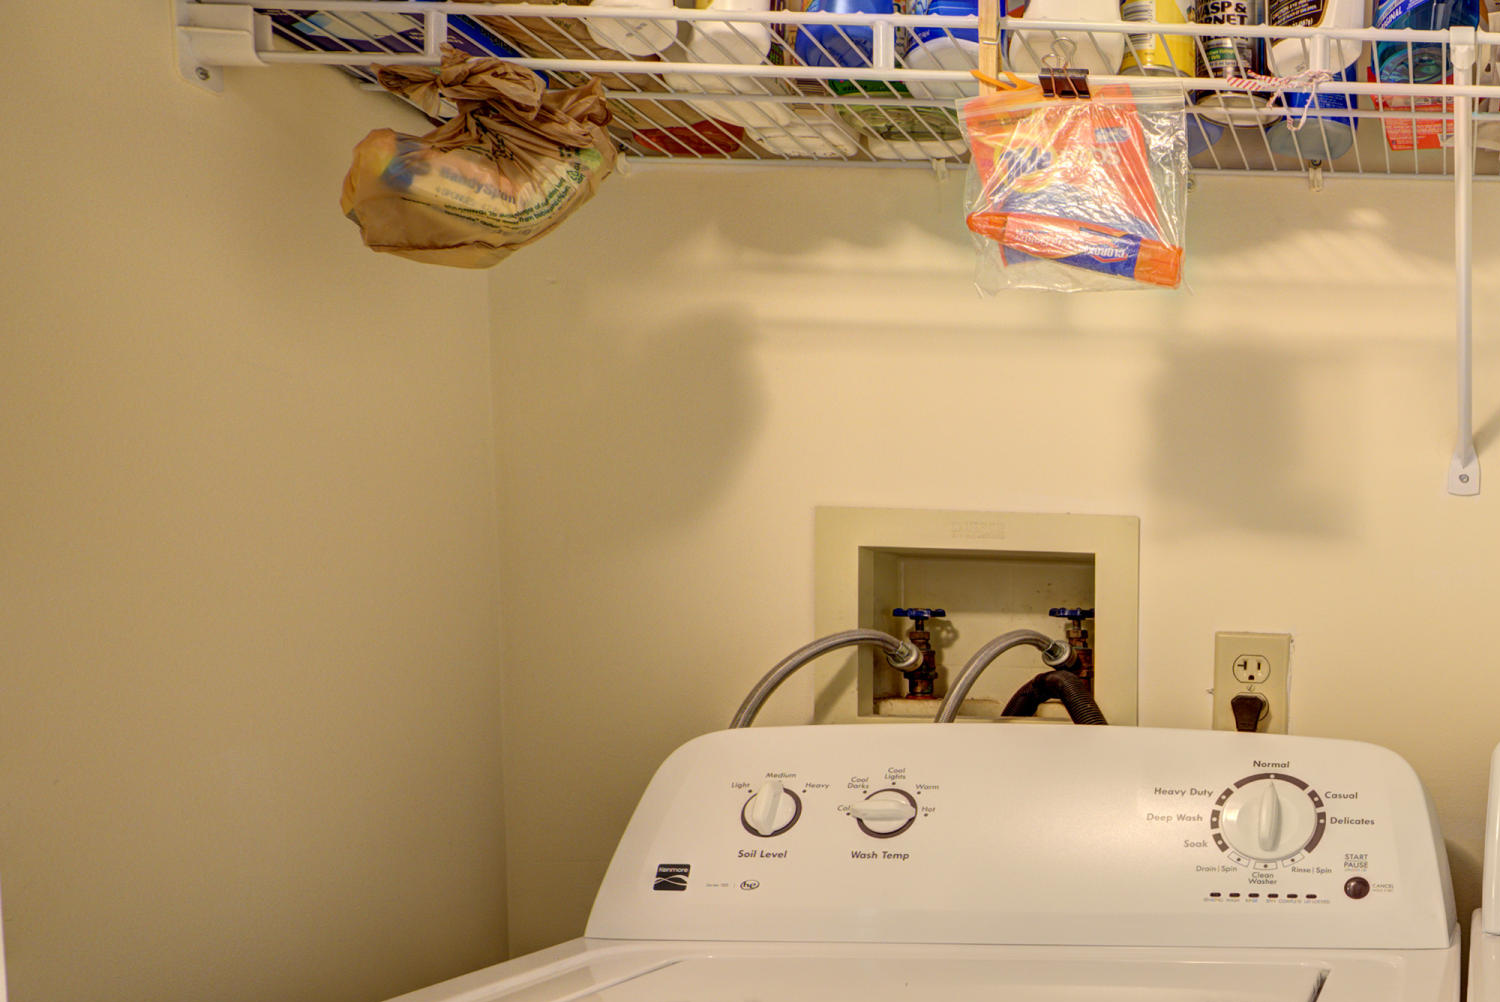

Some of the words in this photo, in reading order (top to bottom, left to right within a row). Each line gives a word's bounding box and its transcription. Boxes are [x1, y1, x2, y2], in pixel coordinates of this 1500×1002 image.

[1203, 1, 1232, 15] ASP
[1203, 14, 1248, 25] RNET
[1253, 760, 1290, 768] Normal
[884, 773, 906, 781] Lights
[731, 781, 750, 790] Light
[805, 782, 830, 790] Heavy
[1154, 787, 1187, 797] Heavy
[1189, 787, 1214, 798] Duty
[1324, 791, 1358, 800] Casual
[1146, 813, 1173, 824] Deep
[1176, 813, 1204, 822] Wash
[1330, 817, 1375, 826] Delicates
[1183, 839, 1208, 848] Soak
[737, 850, 757, 859] Soil
[760, 850, 787, 859] Level
[851, 851, 878, 859] Wash
[882, 851, 910, 861] Temp
[1221, 865, 1238, 874] Spin
[1316, 867, 1332, 875] Spin
